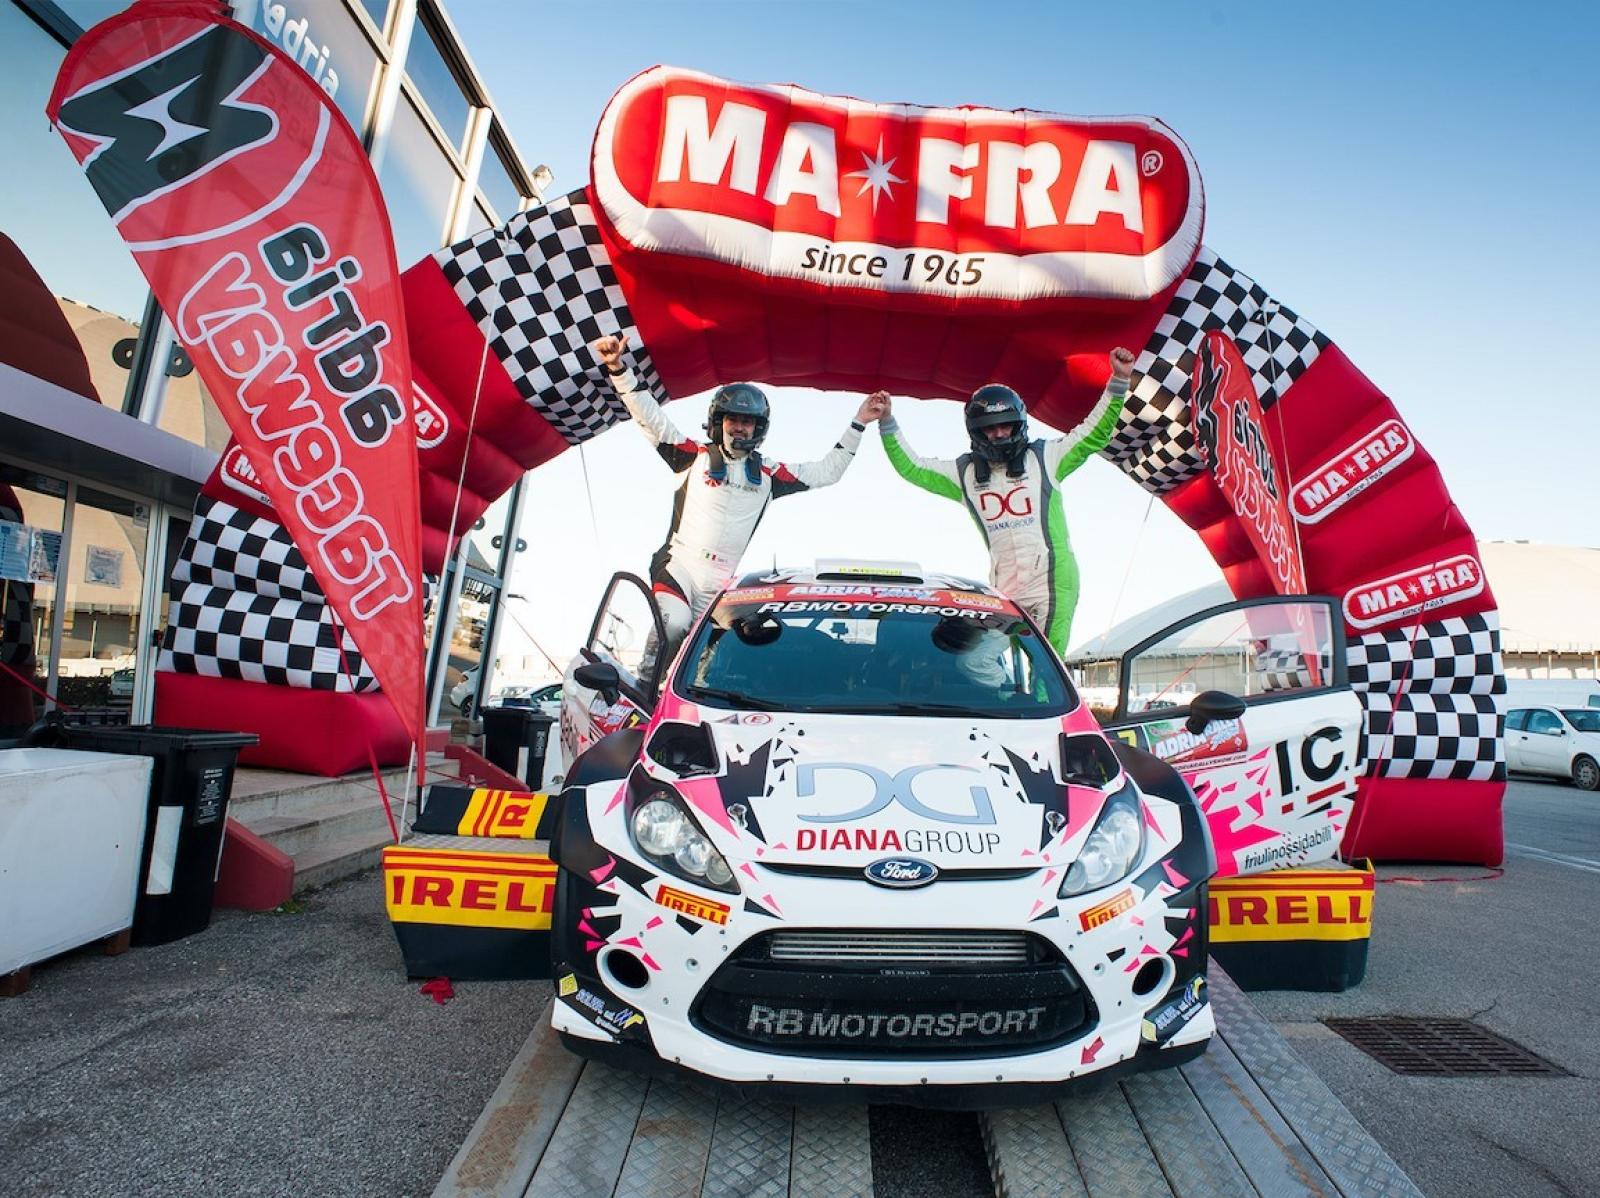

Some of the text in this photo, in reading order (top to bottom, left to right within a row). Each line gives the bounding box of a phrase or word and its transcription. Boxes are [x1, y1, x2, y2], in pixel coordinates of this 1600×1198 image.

[800, 242, 985, 286] since 1965
[1346, 469, 1384, 499] since 1965
[979, 485, 1032, 521] DG
[786, 585, 872, 597] ADRIA
[796, 762, 998, 825] DG
[879, 860, 922, 881] Ford
[656, 885, 730, 926] PIRELLI
